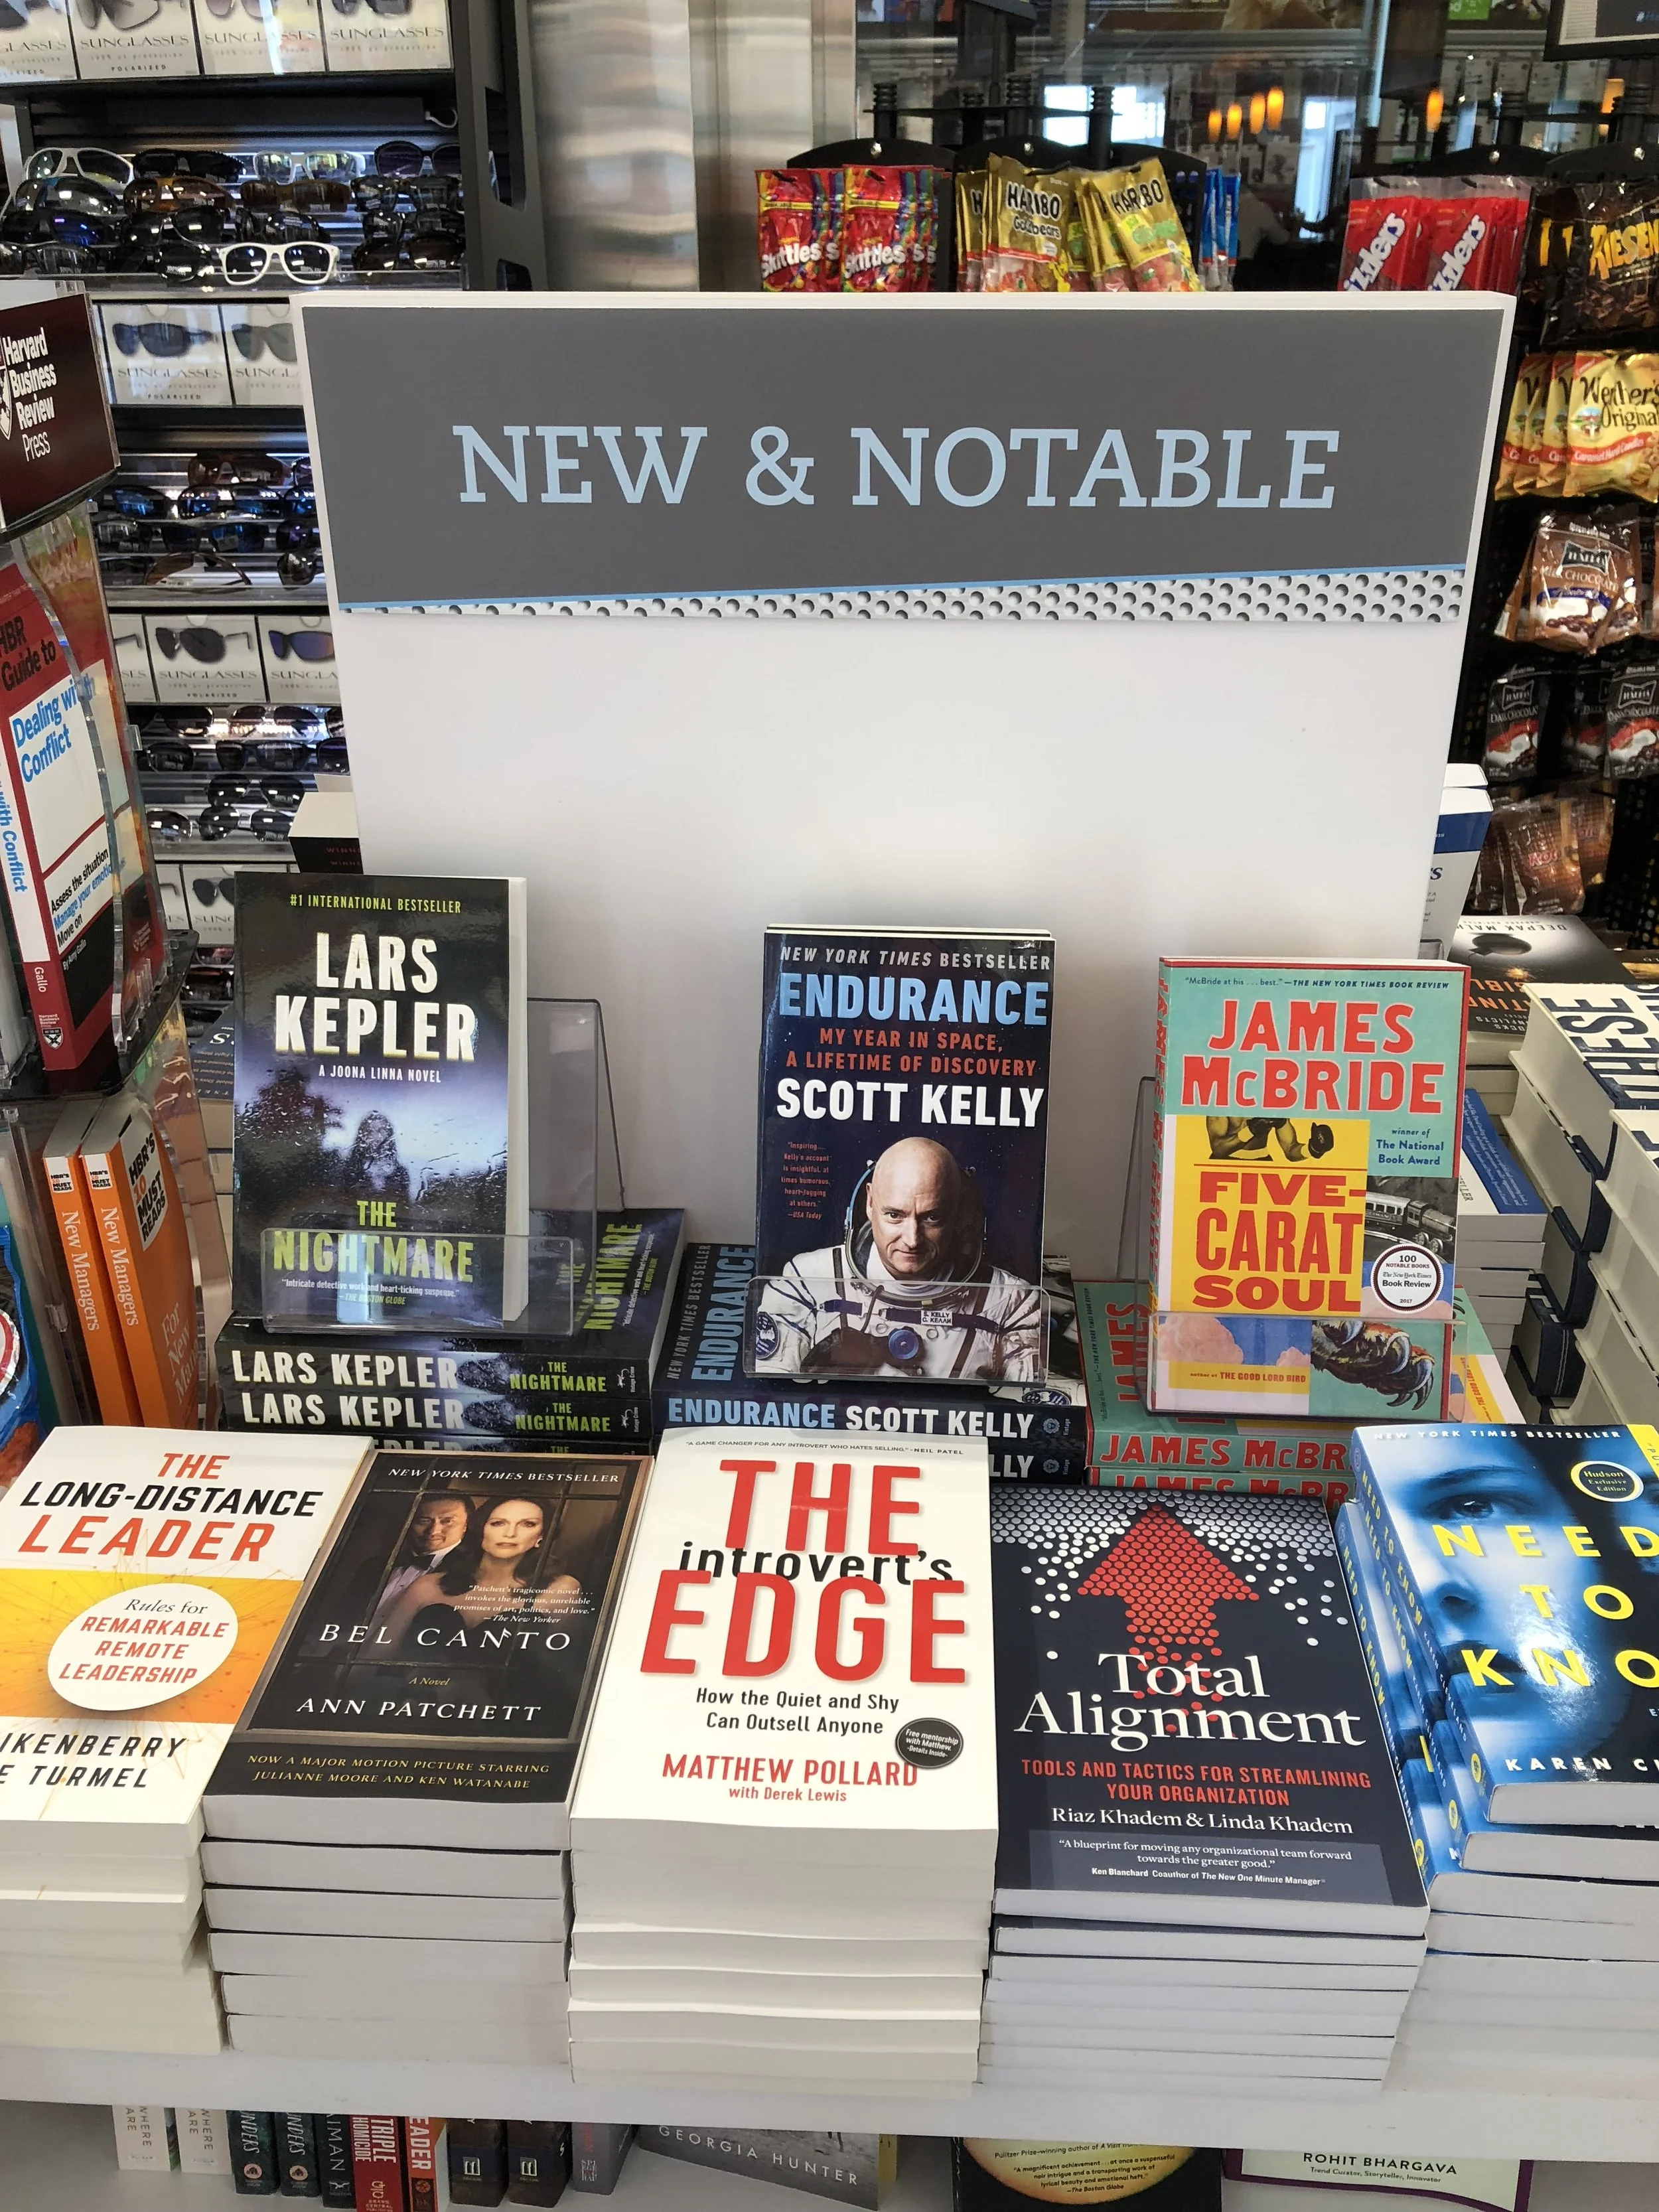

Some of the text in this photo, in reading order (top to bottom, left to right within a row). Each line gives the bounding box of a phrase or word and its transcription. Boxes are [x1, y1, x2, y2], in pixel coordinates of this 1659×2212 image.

[80, 35, 190, 51] SUNGLASSES
[330, 27, 444, 40] SUNGLASSES
[1006, 181, 1061, 220] HARIBO
[2, 327, 48, 366] Harvard
[10, 362, 57, 398] Business
[16, 396, 54, 430] Review
[22, 431, 50, 462] Press
[453, 425, 1341, 509] NEW & NOTABLE
[1, 639, 56, 692] Guide to
[159, 670, 257, 680] SUNGLASSES
[13, 697, 62, 749] Dealing
[21, 723, 72, 782] Conflict
[2, 830, 27, 893] Conflict
[51, 848, 109, 914] Assess the situation
[290, 894, 461, 914] #1 INTERNATIONAL BESTSELLER
[316, 932, 438, 994] LARS
[780, 946, 1050, 970] NEW YORK TIMES BESTSELLER
[34, 966, 46, 994] Gallo
[779, 972, 1049, 1026] ENDURANCE
[274, 995, 478, 1061] KEPLER
[820, 1028, 1003, 1053] MY YEAR IN SPACE,
[1208, 999, 1415, 1055] JAMES
[319, 1065, 441, 1083] A JOONA LINNA NOVEL
[786, 1051, 1036, 1076] A LIFETIME OF DISCOVERY
[776, 1078, 1045, 1128] SCOTT KELLY
[1376, 1139, 1444, 1151] The National
[1392, 1128, 1431, 1138] winner of
[129, 1132, 155, 1187] HBR'S
[1378, 1153, 1441, 1166] Book Award
[133, 1176, 147, 1205] 10
[137, 1170, 163, 1225] MUST
[1200, 1171, 1367, 1208] FIVE-
[141, 1193, 166, 1244] READS
[356, 1201, 397, 1227] THE
[273, 1230, 474, 1283] NIGHTMARE
[1195, 1207, 1364, 1275] CARAT
[100, 1207, 139, 1327] New Managers
[1192, 1275, 1362, 1312] SOUL
[231, 1350, 461, 1389] LARS KEPLER
[510, 1373, 607, 1392] NIGHTMARE
[547, 1361, 568, 1375] THE
[1220, 1371, 1306, 1383] THE GOOD LORD BIRD
[668, 1398, 1034, 1439] ENDURANCE SCOTT KELLY
[1100, 1434, 1231, 1465] JAMES
[1374, 1430, 1622, 1441] NEW YORK TIMES BESTSELLER
[157, 1453, 231, 1480] THE
[478, 1471, 524, 1480] TIMES
[528, 1473, 619, 1483] BESTSELLER
[1583, 1469, 1624, 1478] Hudson
[20, 1481, 325, 1517] LONG-DISTANCE
[719, 1459, 921, 1557] THE
[18, 1514, 277, 1562] LEADER
[1431, 1524, 1659, 1558] NEED
[123, 1599, 208, 1615] Rules for
[1519, 1584, 1635, 1621] TO
[80, 1615, 230, 1639] REMARKABLE
[319, 1623, 571, 1651] BEL CANTO
[640, 1569, 966, 1684] EDGE
[94, 1640, 189, 1659] REMOTE
[58, 1662, 198, 1684] LEADERSHIP
[419, 1677, 451, 1686] Novel
[1098, 1653, 1271, 1698] Total
[297, 1698, 542, 1721] ANN PATCHETT
[696, 1687, 900, 1714] How the Quiet and Shy
[706, 1712, 884, 1737] Can Outsell Anyone
[1013, 1690, 1367, 1753] Alignment
[29, 1765, 149, 1789] TURMEL
[247, 1755, 282, 1764] NOW
[300, 1757, 347, 1767] MAJOR
[352, 1759, 409, 1768] MOTION
[413, 1761, 474, 1771] PICTURE
[478, 1763, 550, 1773] STARRING
[662, 1753, 918, 1786] MATTHEW POLLARD
[1021, 1759, 1372, 1789] TOOLS AND TACTICS FOR STREAMLINING
[1506, 1757, 1612, 1772] KAREN
[729, 1787, 847, 1803] with Derek Lewis
[1106, 1783, 1290, 1806] YOUR ORGANIZATION
[1052, 1807, 1354, 1834] Riaz Khadem & Linda Khadem
[352, 2117, 372, 2162] HOMICIDE
[370, 2118, 397, 2164] TRIPLE
[659, 2125, 857, 2185] GEORGIA HUNTER
[1303, 2152, 1458, 2175] ROHIT BHARGAVA
